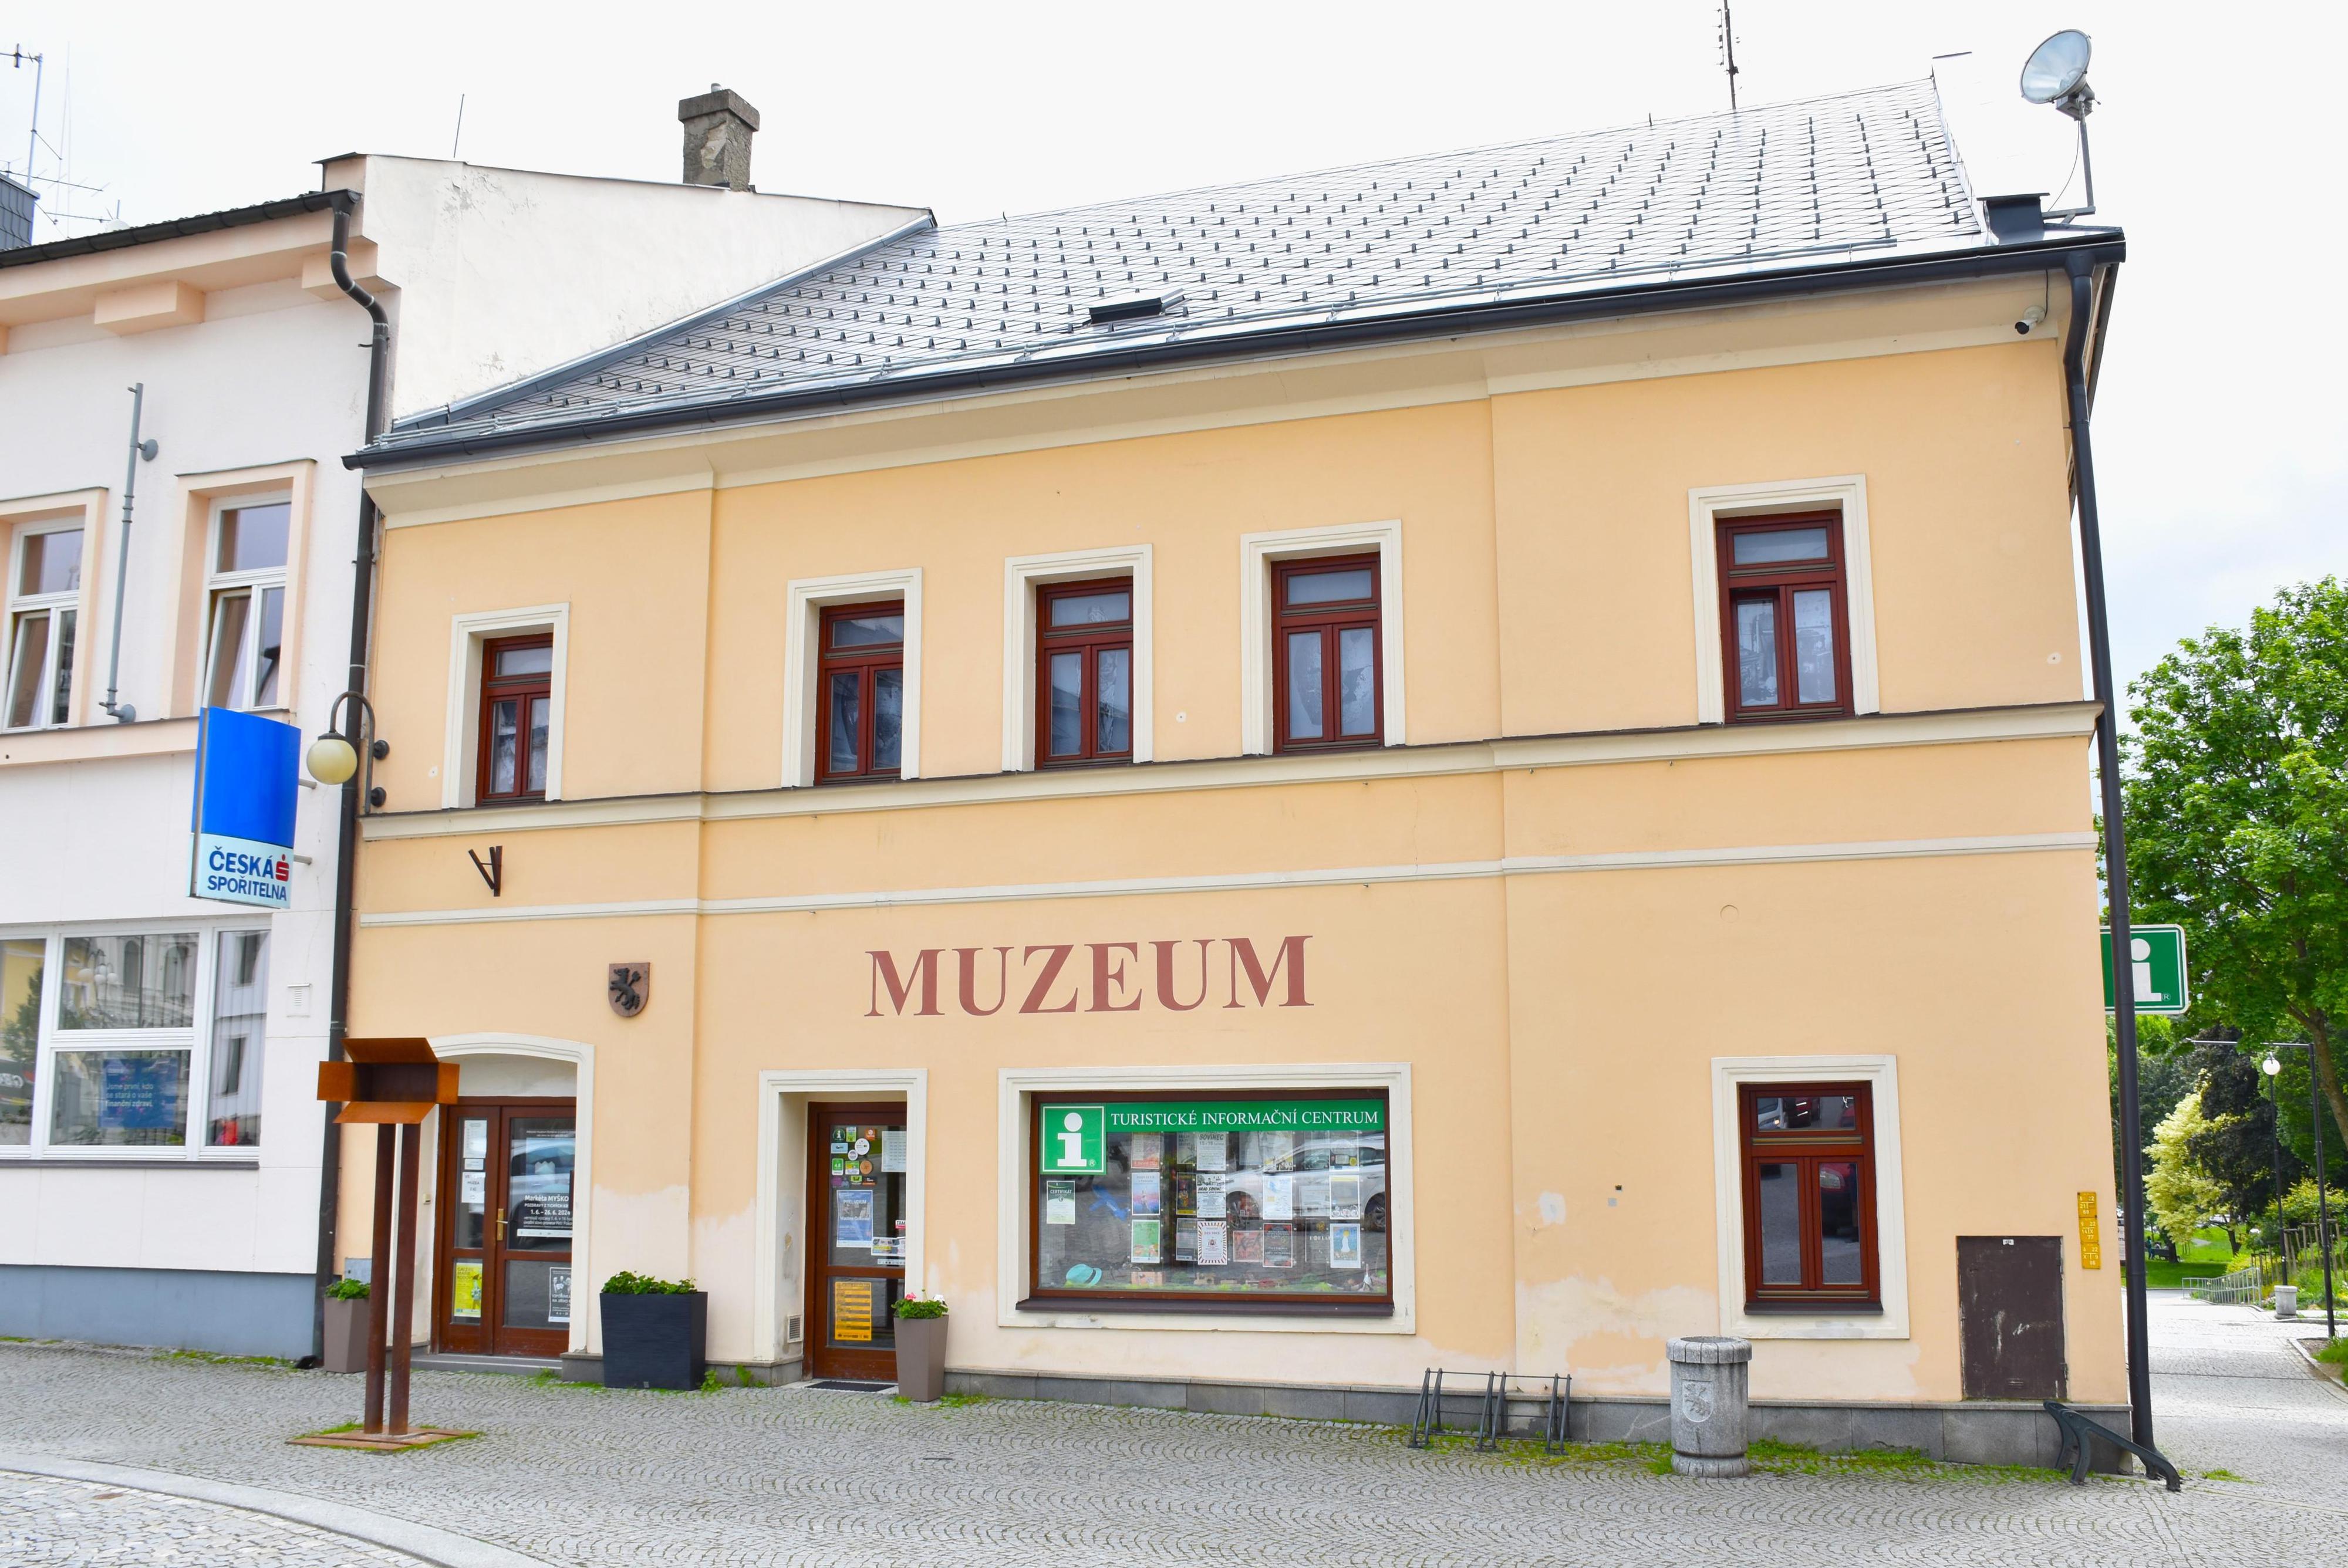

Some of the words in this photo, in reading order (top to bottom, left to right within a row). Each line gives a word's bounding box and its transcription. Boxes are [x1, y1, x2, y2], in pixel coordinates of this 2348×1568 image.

[209, 846, 274, 879] ČESKÁ
[207, 876, 287, 901] SPOŘITELNA
[864, 935, 1315, 1017] MUZEUM
[1111, 1110, 1197, 1126] TURISTICKÉ
[1202, 1109, 1298, 1125] INFORMAČNÍ
[1301, 1111, 1378, 1124] CENTRUM
